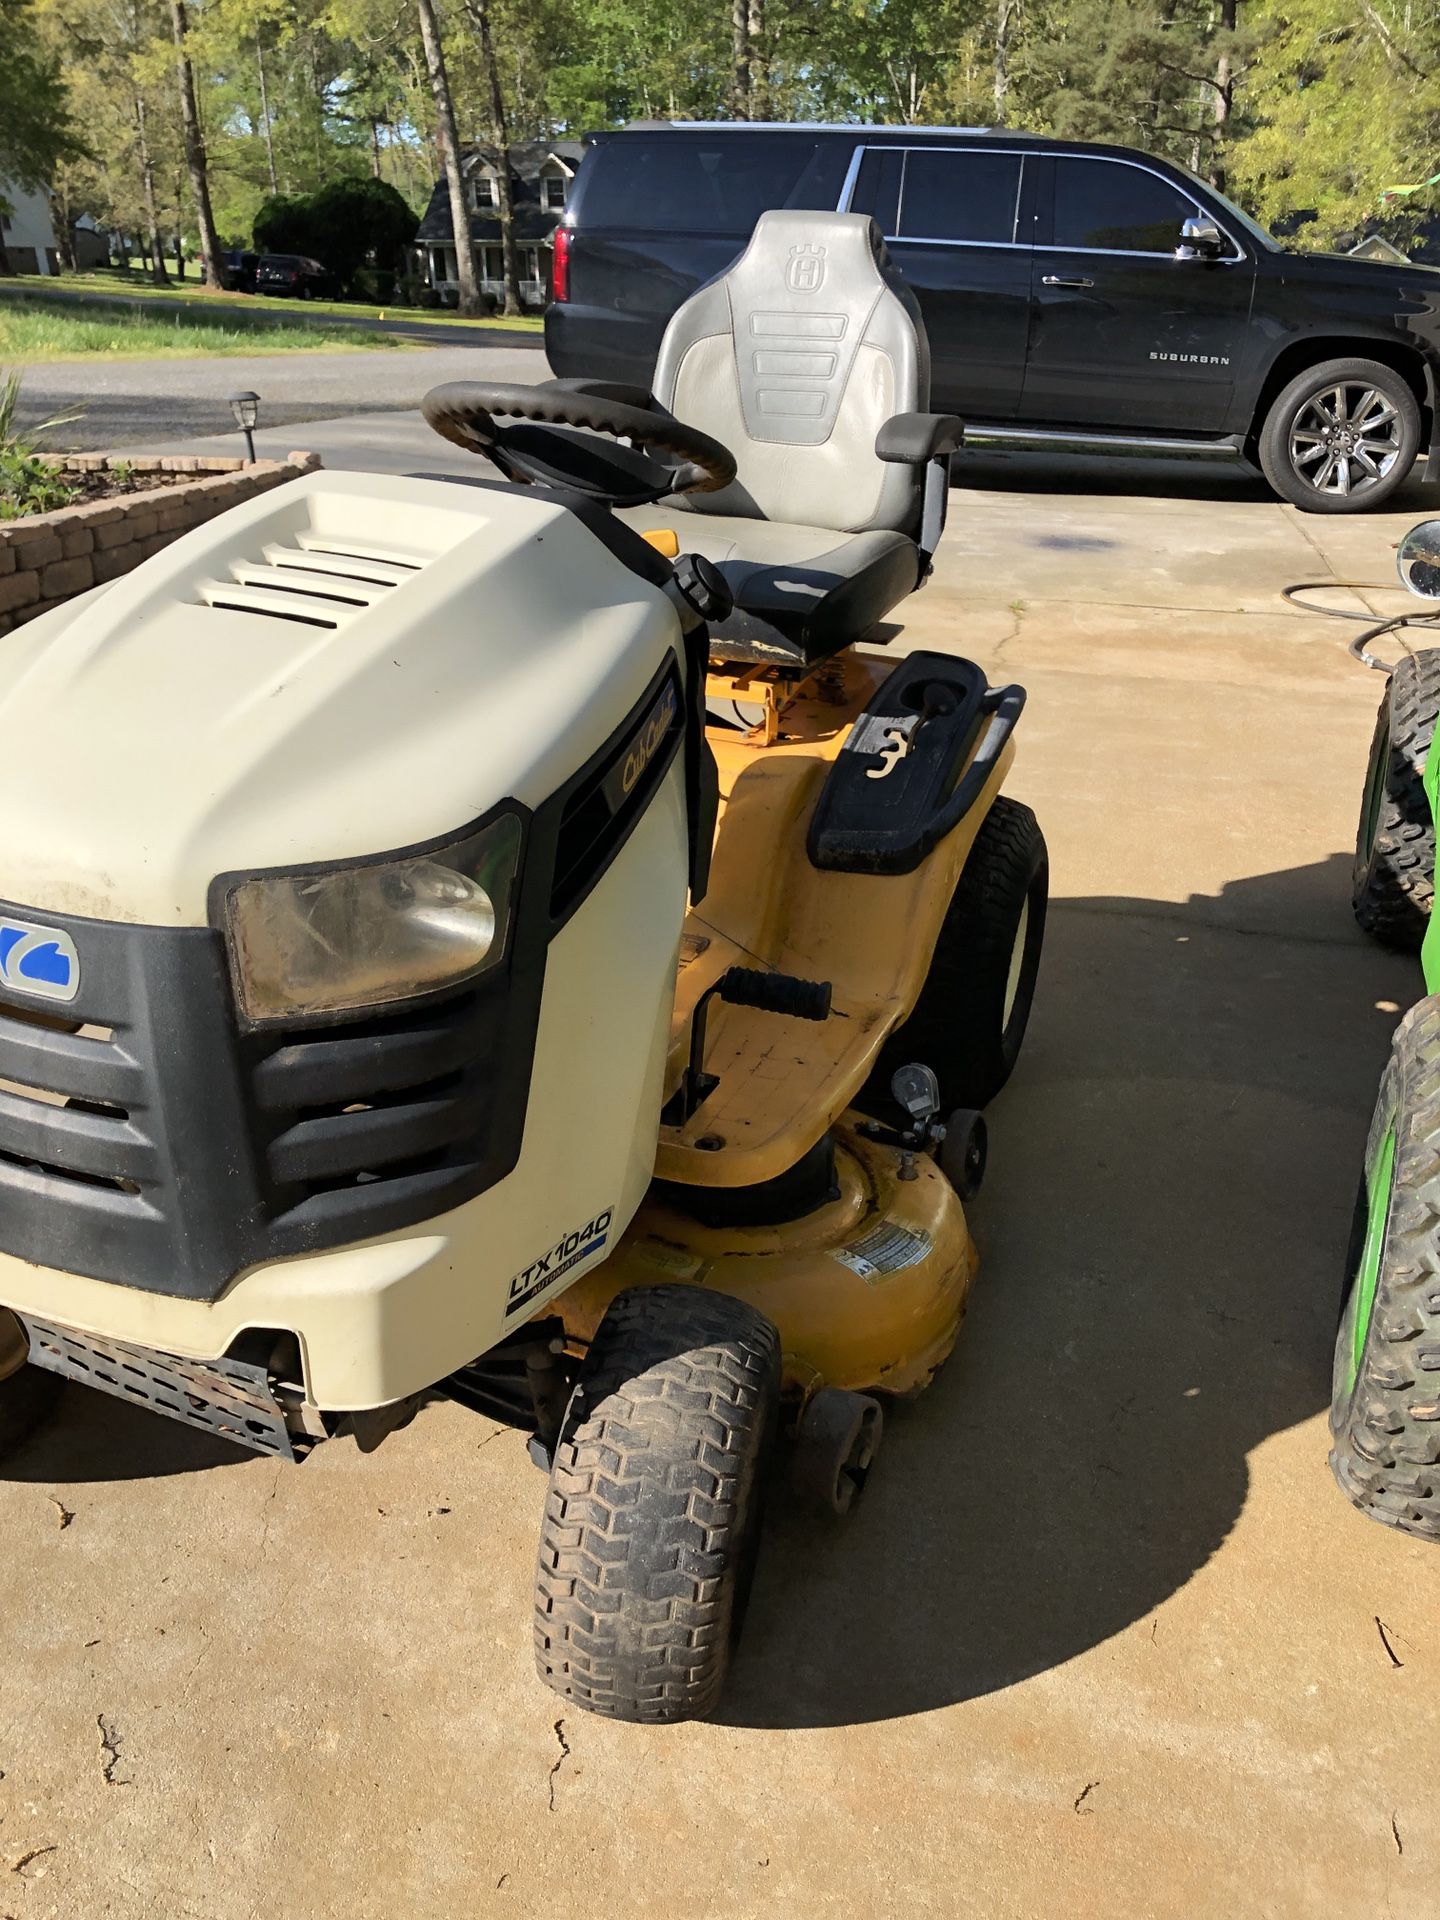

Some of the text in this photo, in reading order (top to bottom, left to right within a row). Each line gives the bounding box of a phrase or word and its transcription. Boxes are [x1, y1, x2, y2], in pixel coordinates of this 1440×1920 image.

[1149, 351, 1230, 365] SUBURBAN
[509, 1210, 612, 1299] LTX 1040
